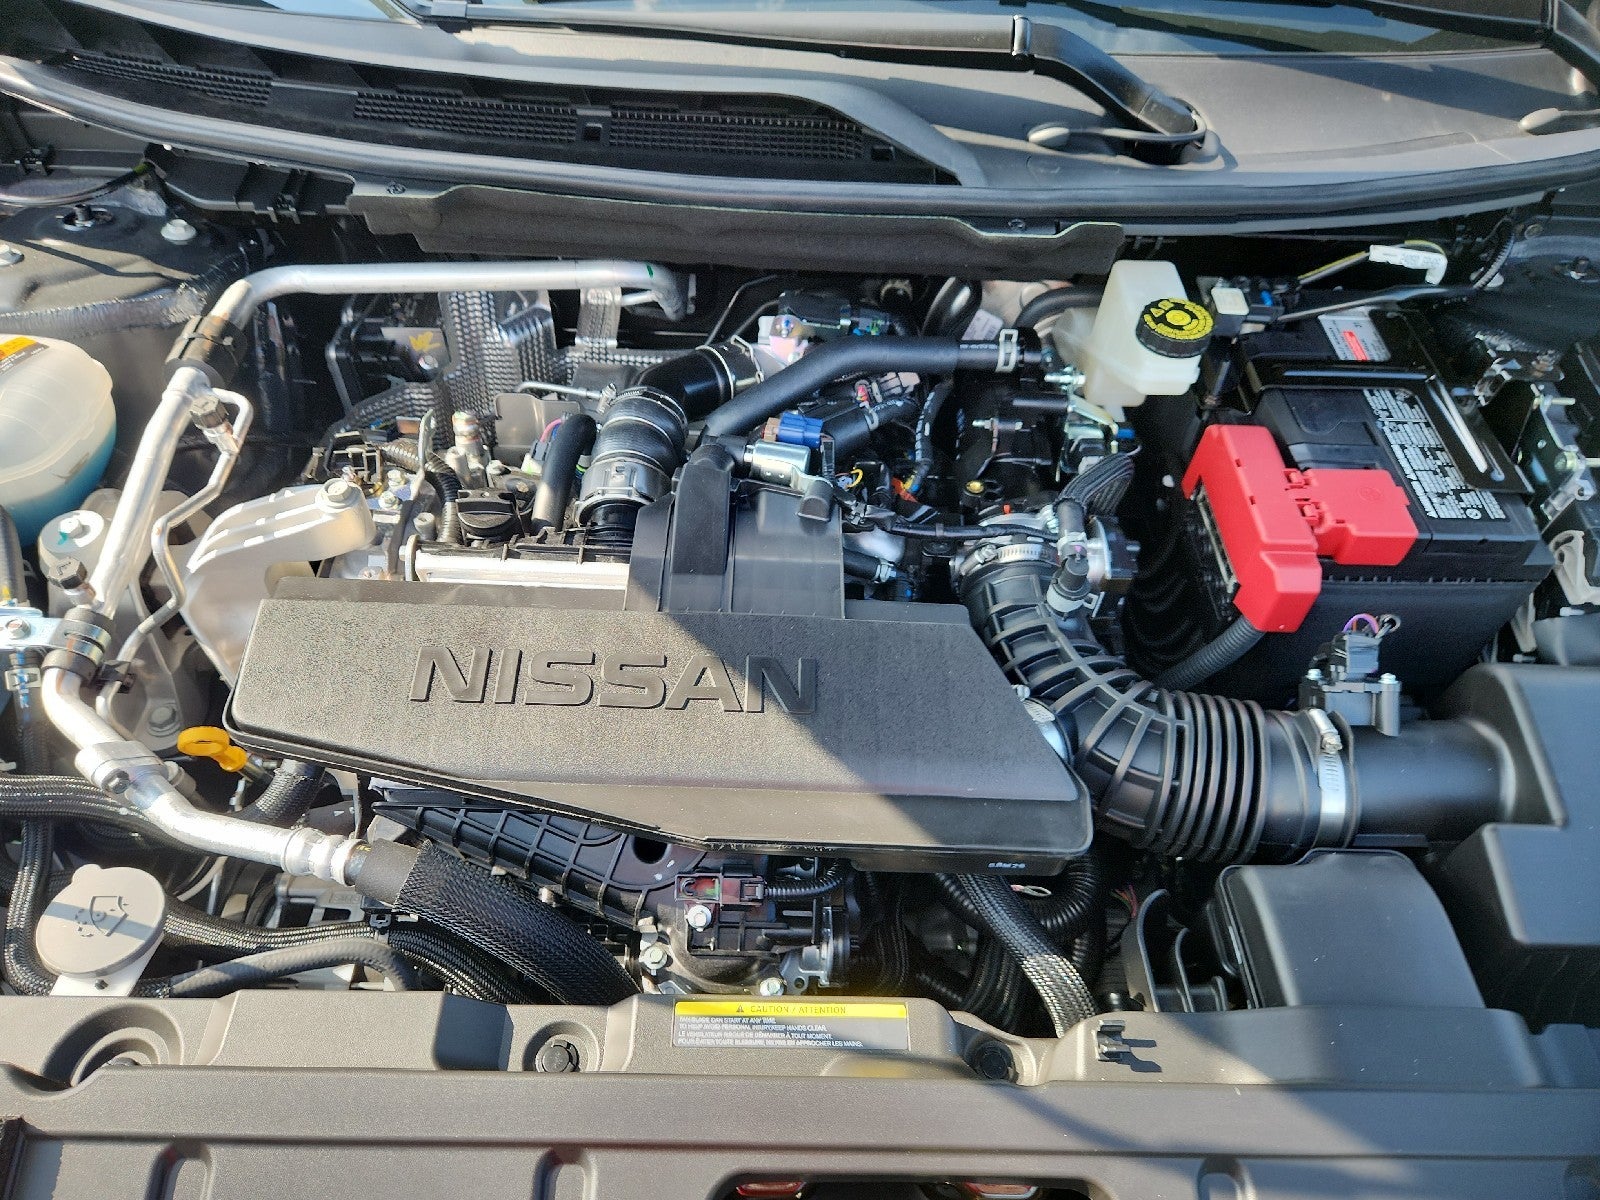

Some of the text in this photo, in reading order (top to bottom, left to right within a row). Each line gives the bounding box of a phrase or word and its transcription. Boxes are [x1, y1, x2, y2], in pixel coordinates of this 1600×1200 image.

[410, 646, 817, 715] NISSAN
[751, 1005, 789, 1013] CAUTION
[798, 1006, 846, 1014] ATTENTION
